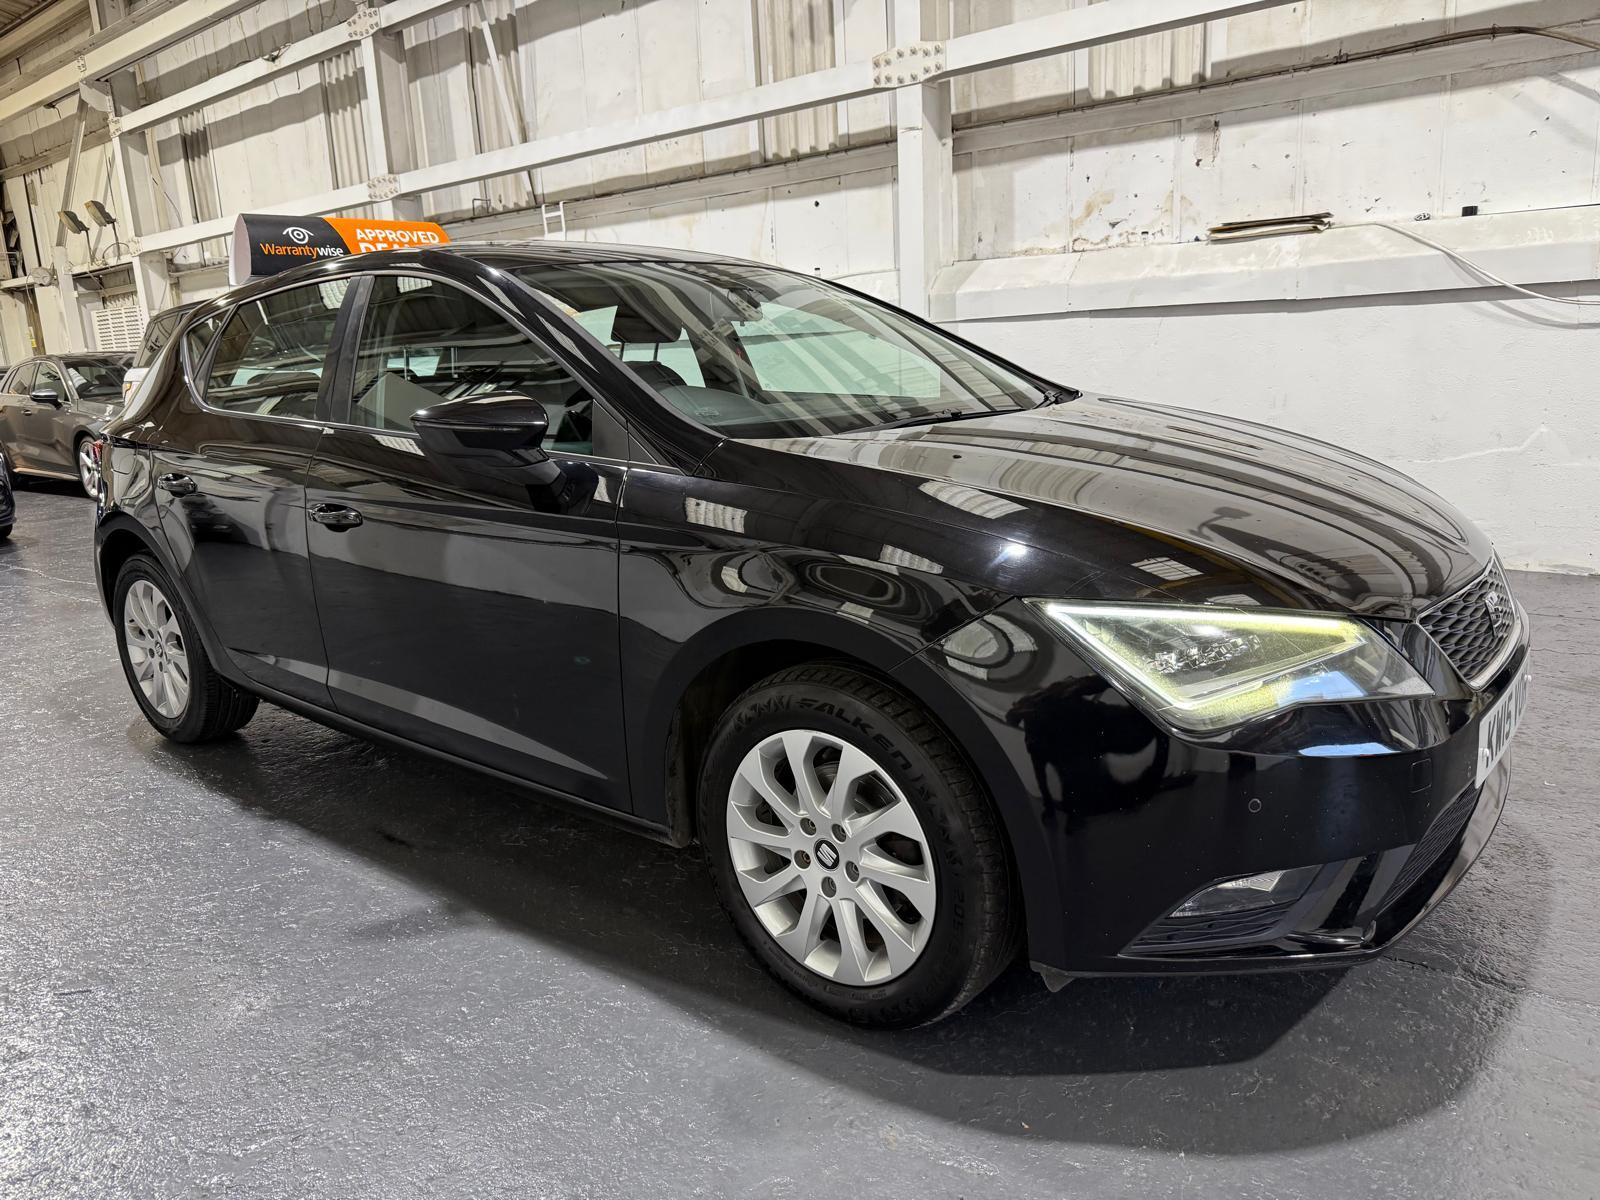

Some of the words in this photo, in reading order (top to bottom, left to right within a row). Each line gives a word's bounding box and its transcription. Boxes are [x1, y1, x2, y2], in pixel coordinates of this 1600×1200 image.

[355, 228, 440, 244] APPROVED
[259, 242, 344, 260] Warrantywise
[798, 700, 913, 770] FALKEN
